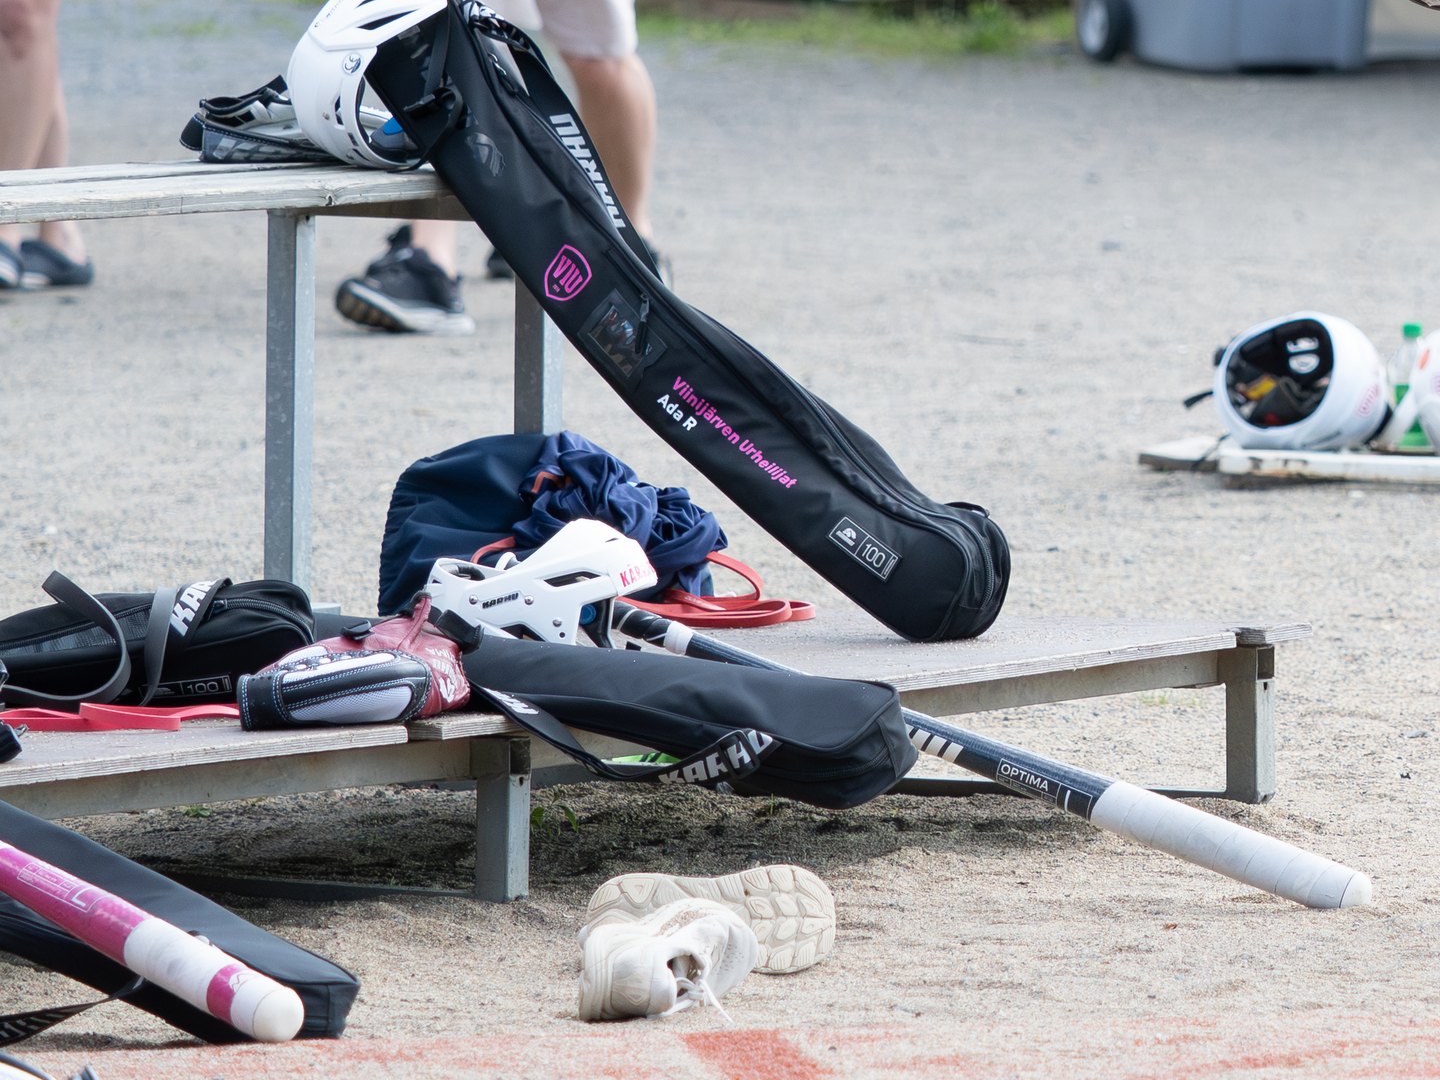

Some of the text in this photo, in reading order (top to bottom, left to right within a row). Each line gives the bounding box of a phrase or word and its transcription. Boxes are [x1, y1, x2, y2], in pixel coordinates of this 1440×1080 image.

[552, 254, 584, 294] VIU
[656, 393, 698, 432] Ada R
[672, 375, 798, 489] Viinijärven Urheilijat
[861, 543, 886, 568] 100
[482, 592, 519, 610] KARHU
[187, 681, 219, 694] 100
[1000, 763, 1050, 792] OPTIMA
